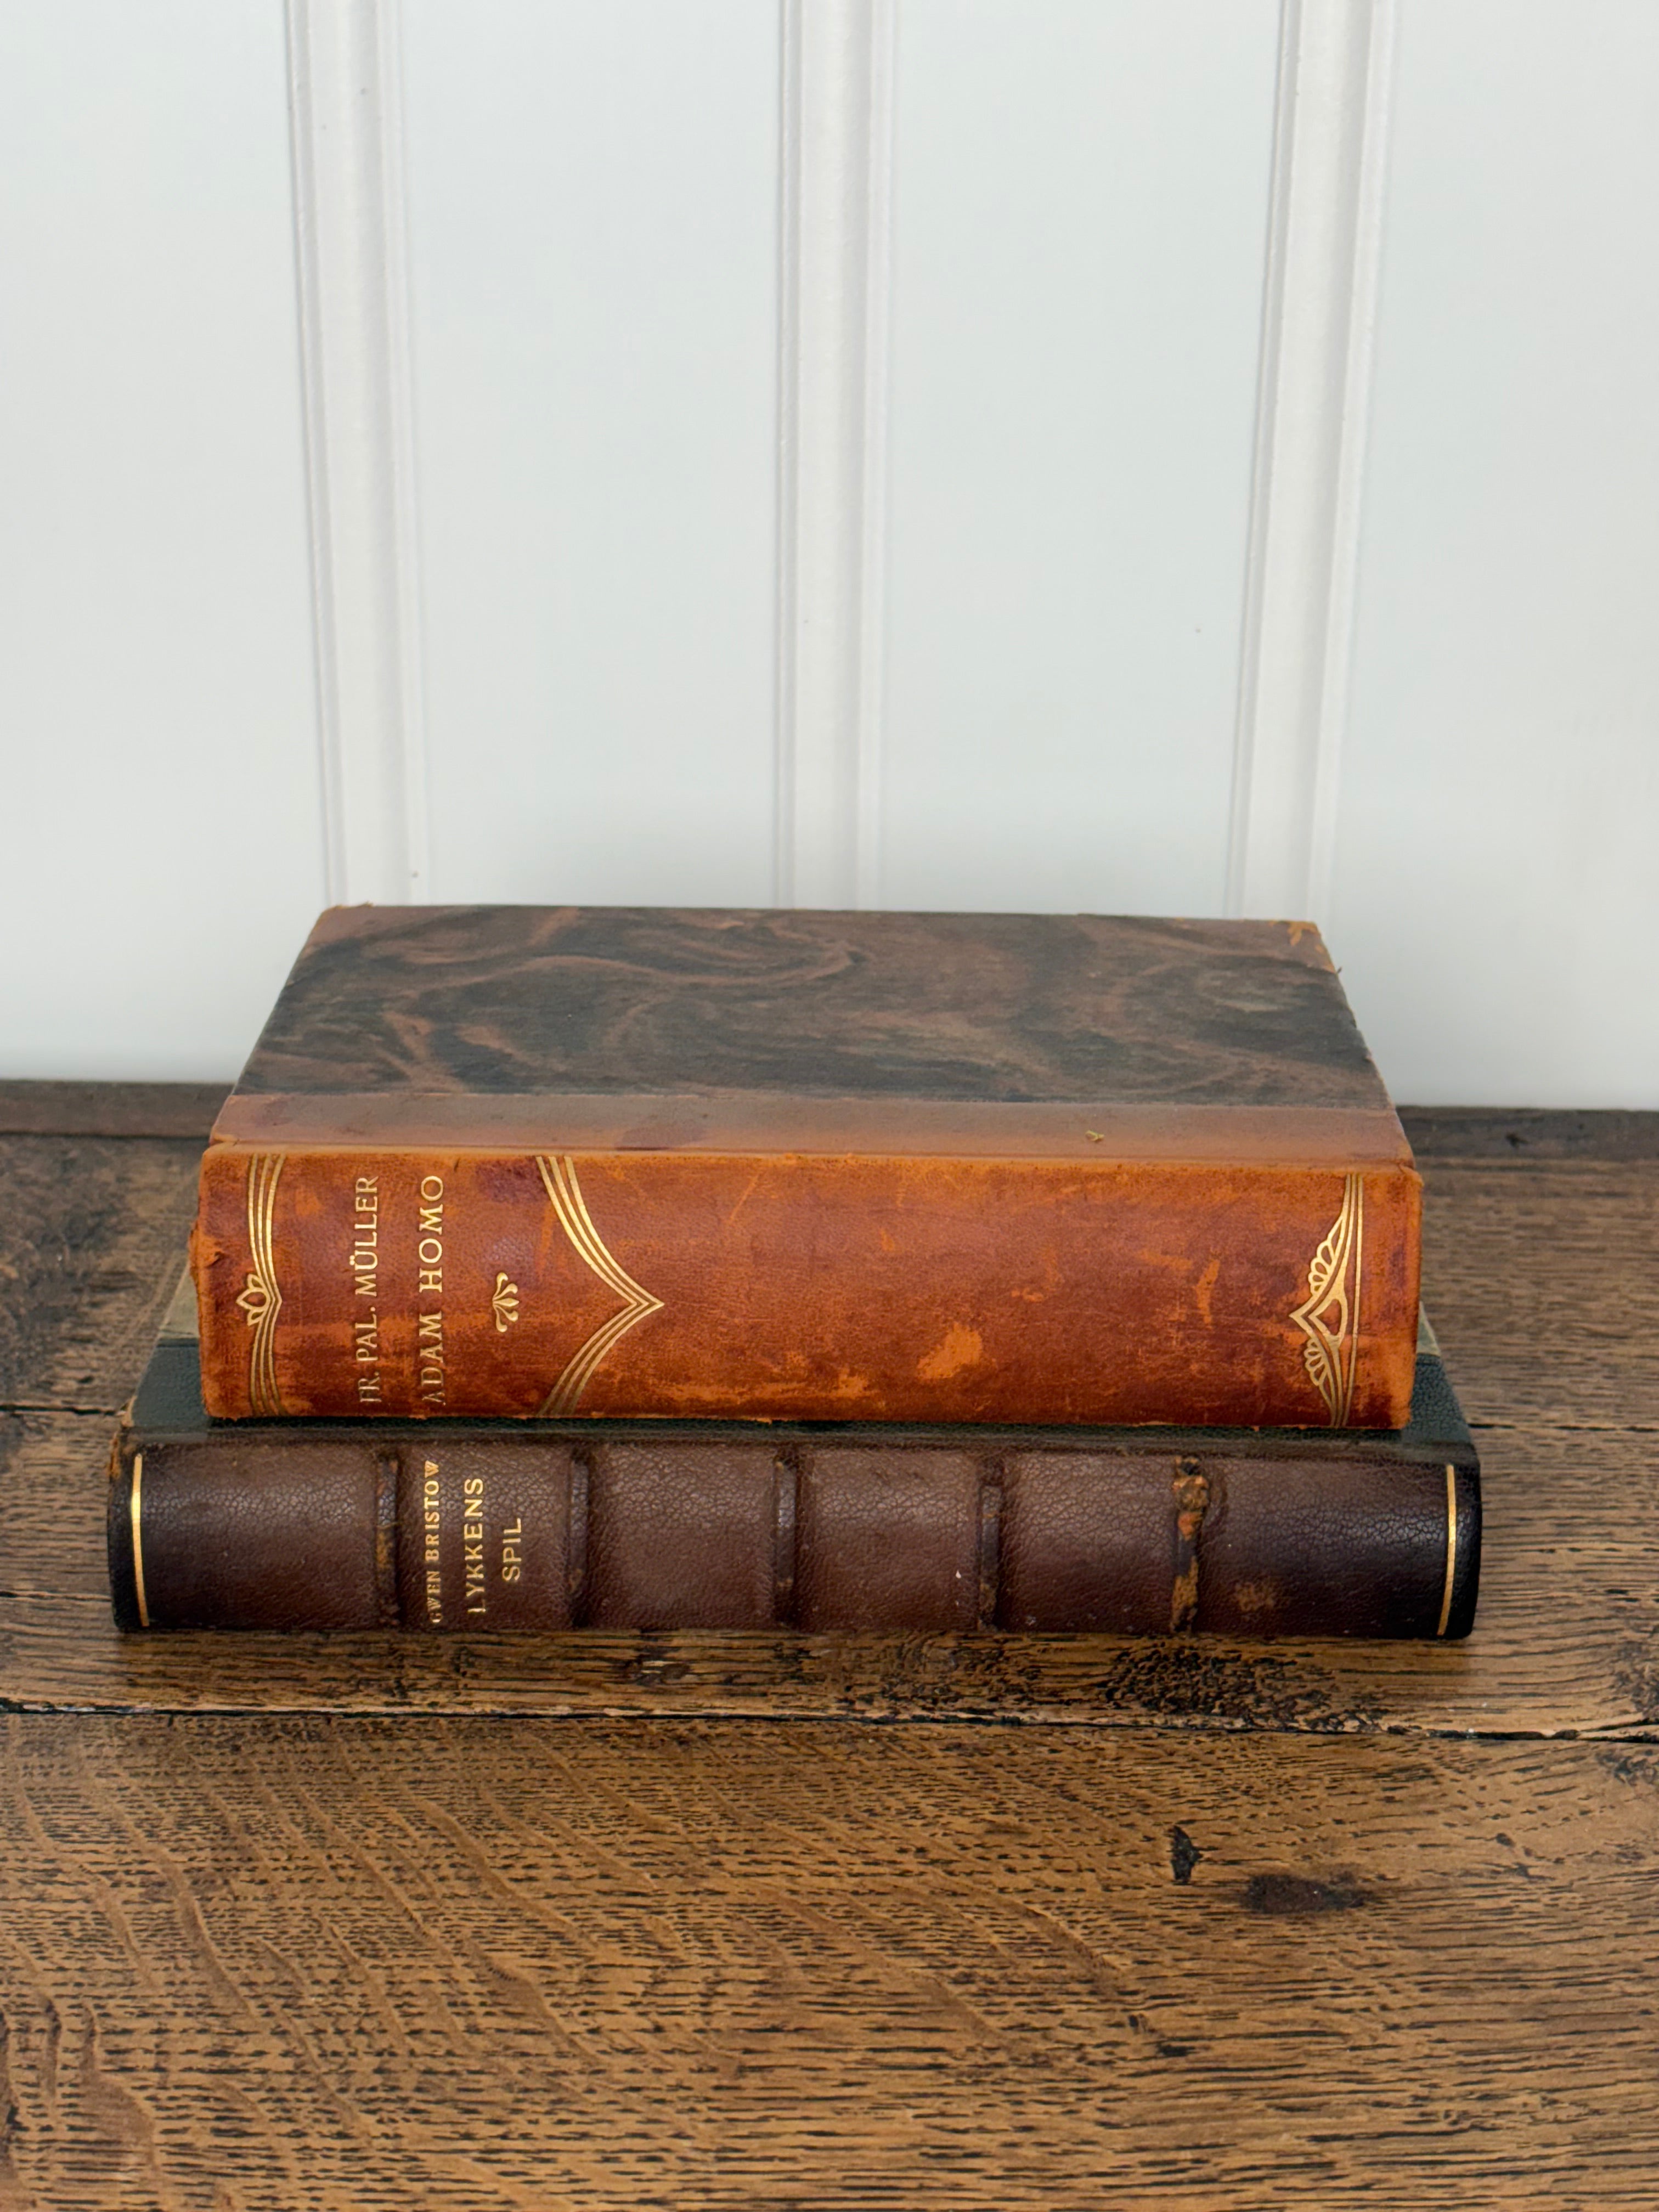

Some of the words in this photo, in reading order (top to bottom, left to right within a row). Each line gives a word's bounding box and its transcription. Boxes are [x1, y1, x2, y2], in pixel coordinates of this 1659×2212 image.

[349, 1176, 379, 1296] MÜLLER
[418, 1175, 443, 1293] HOMO
[356, 1306, 379, 1362] PAL.
[418, 1311, 447, 1406] ADAM
[424, 1460, 440, 1561] BRISTOW
[464, 1478, 486, 1613] LYKKENS
[501, 1518, 522, 1581] SPIL
[426, 1571, 442, 1623] GWEN
